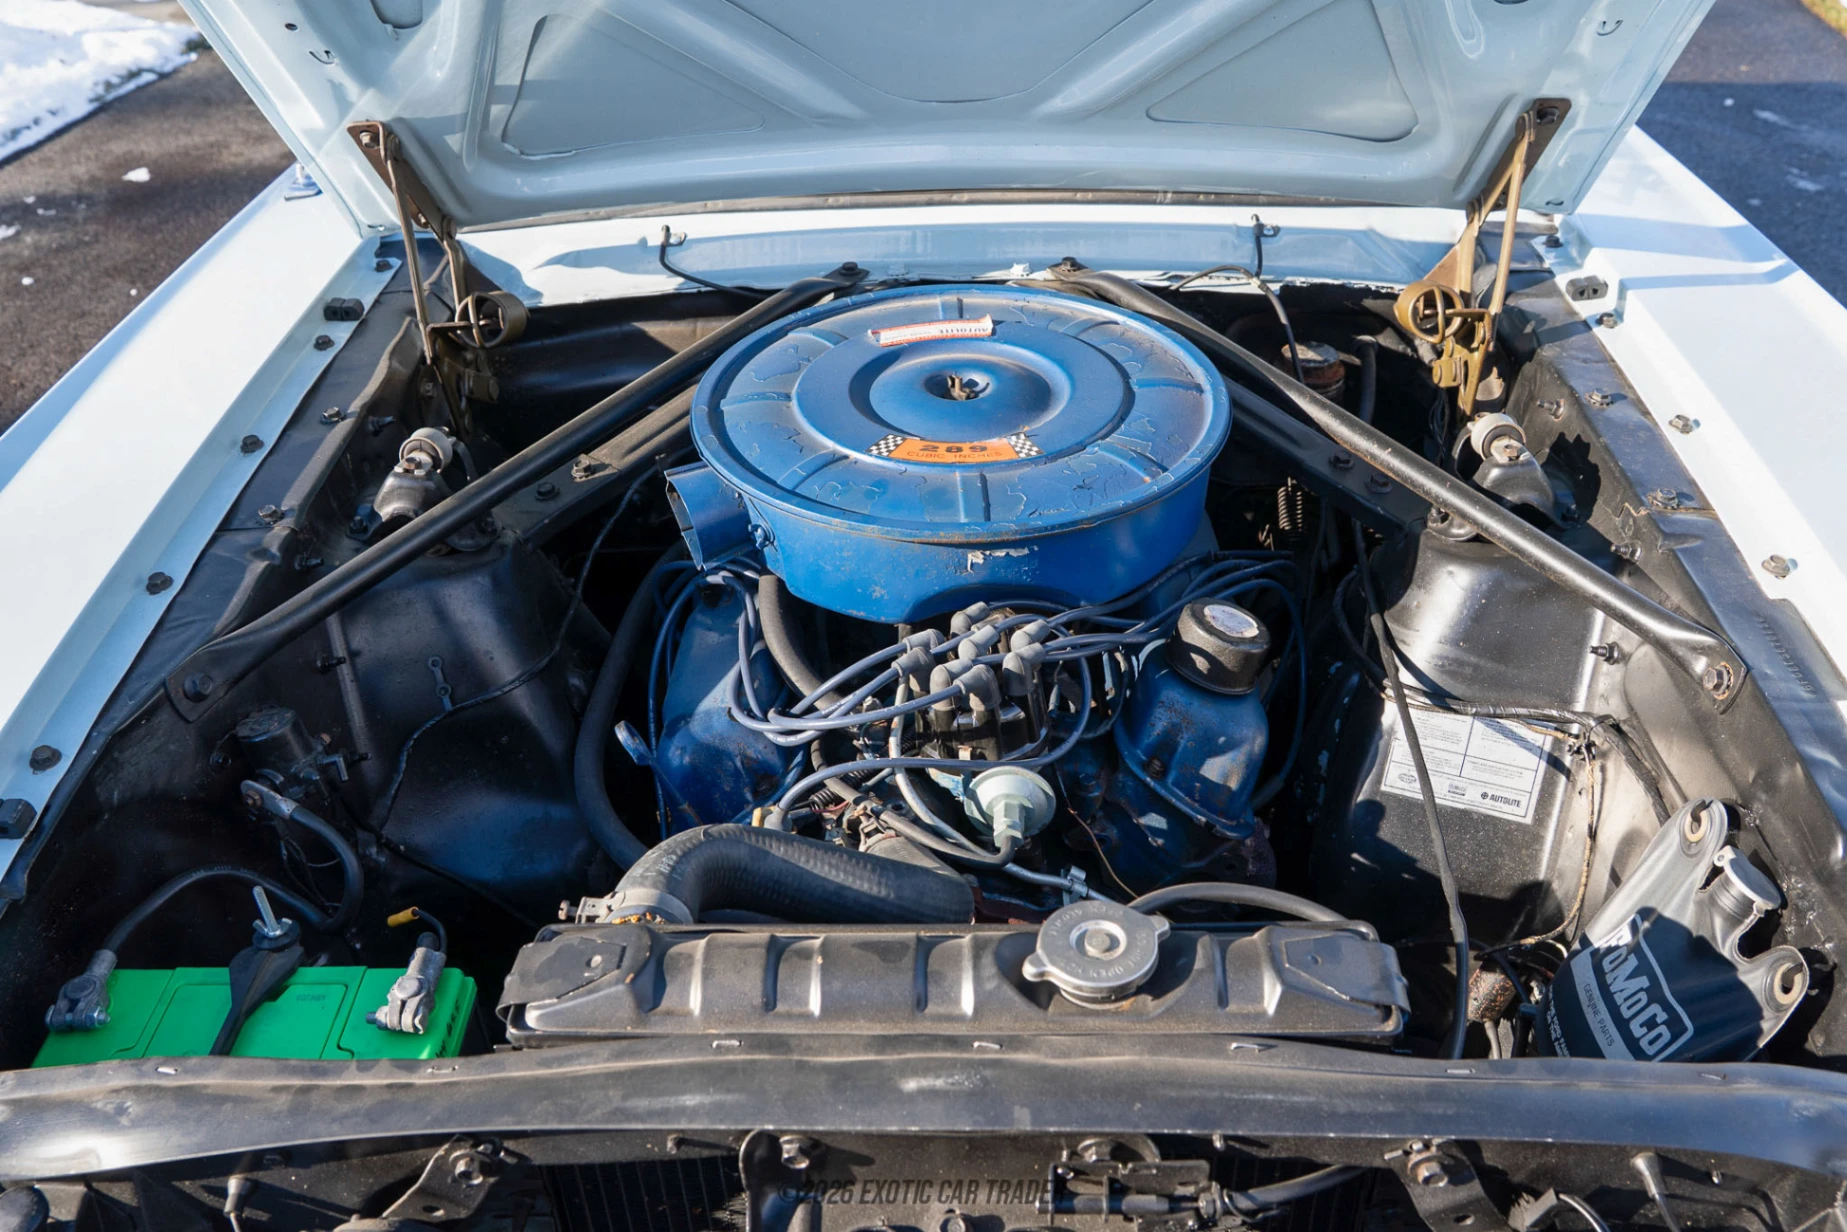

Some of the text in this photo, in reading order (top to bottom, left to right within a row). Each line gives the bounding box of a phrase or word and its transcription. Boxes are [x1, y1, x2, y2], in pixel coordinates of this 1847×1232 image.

[906, 451, 1003, 460] CUBIC INCHES
[919, 444, 989, 453] 289
[1488, 793, 1521, 808] AUTOLITE
[1599, 921, 1672, 1056] FoMoCo
[1583, 983, 1615, 1047] GENUINE PARTS
